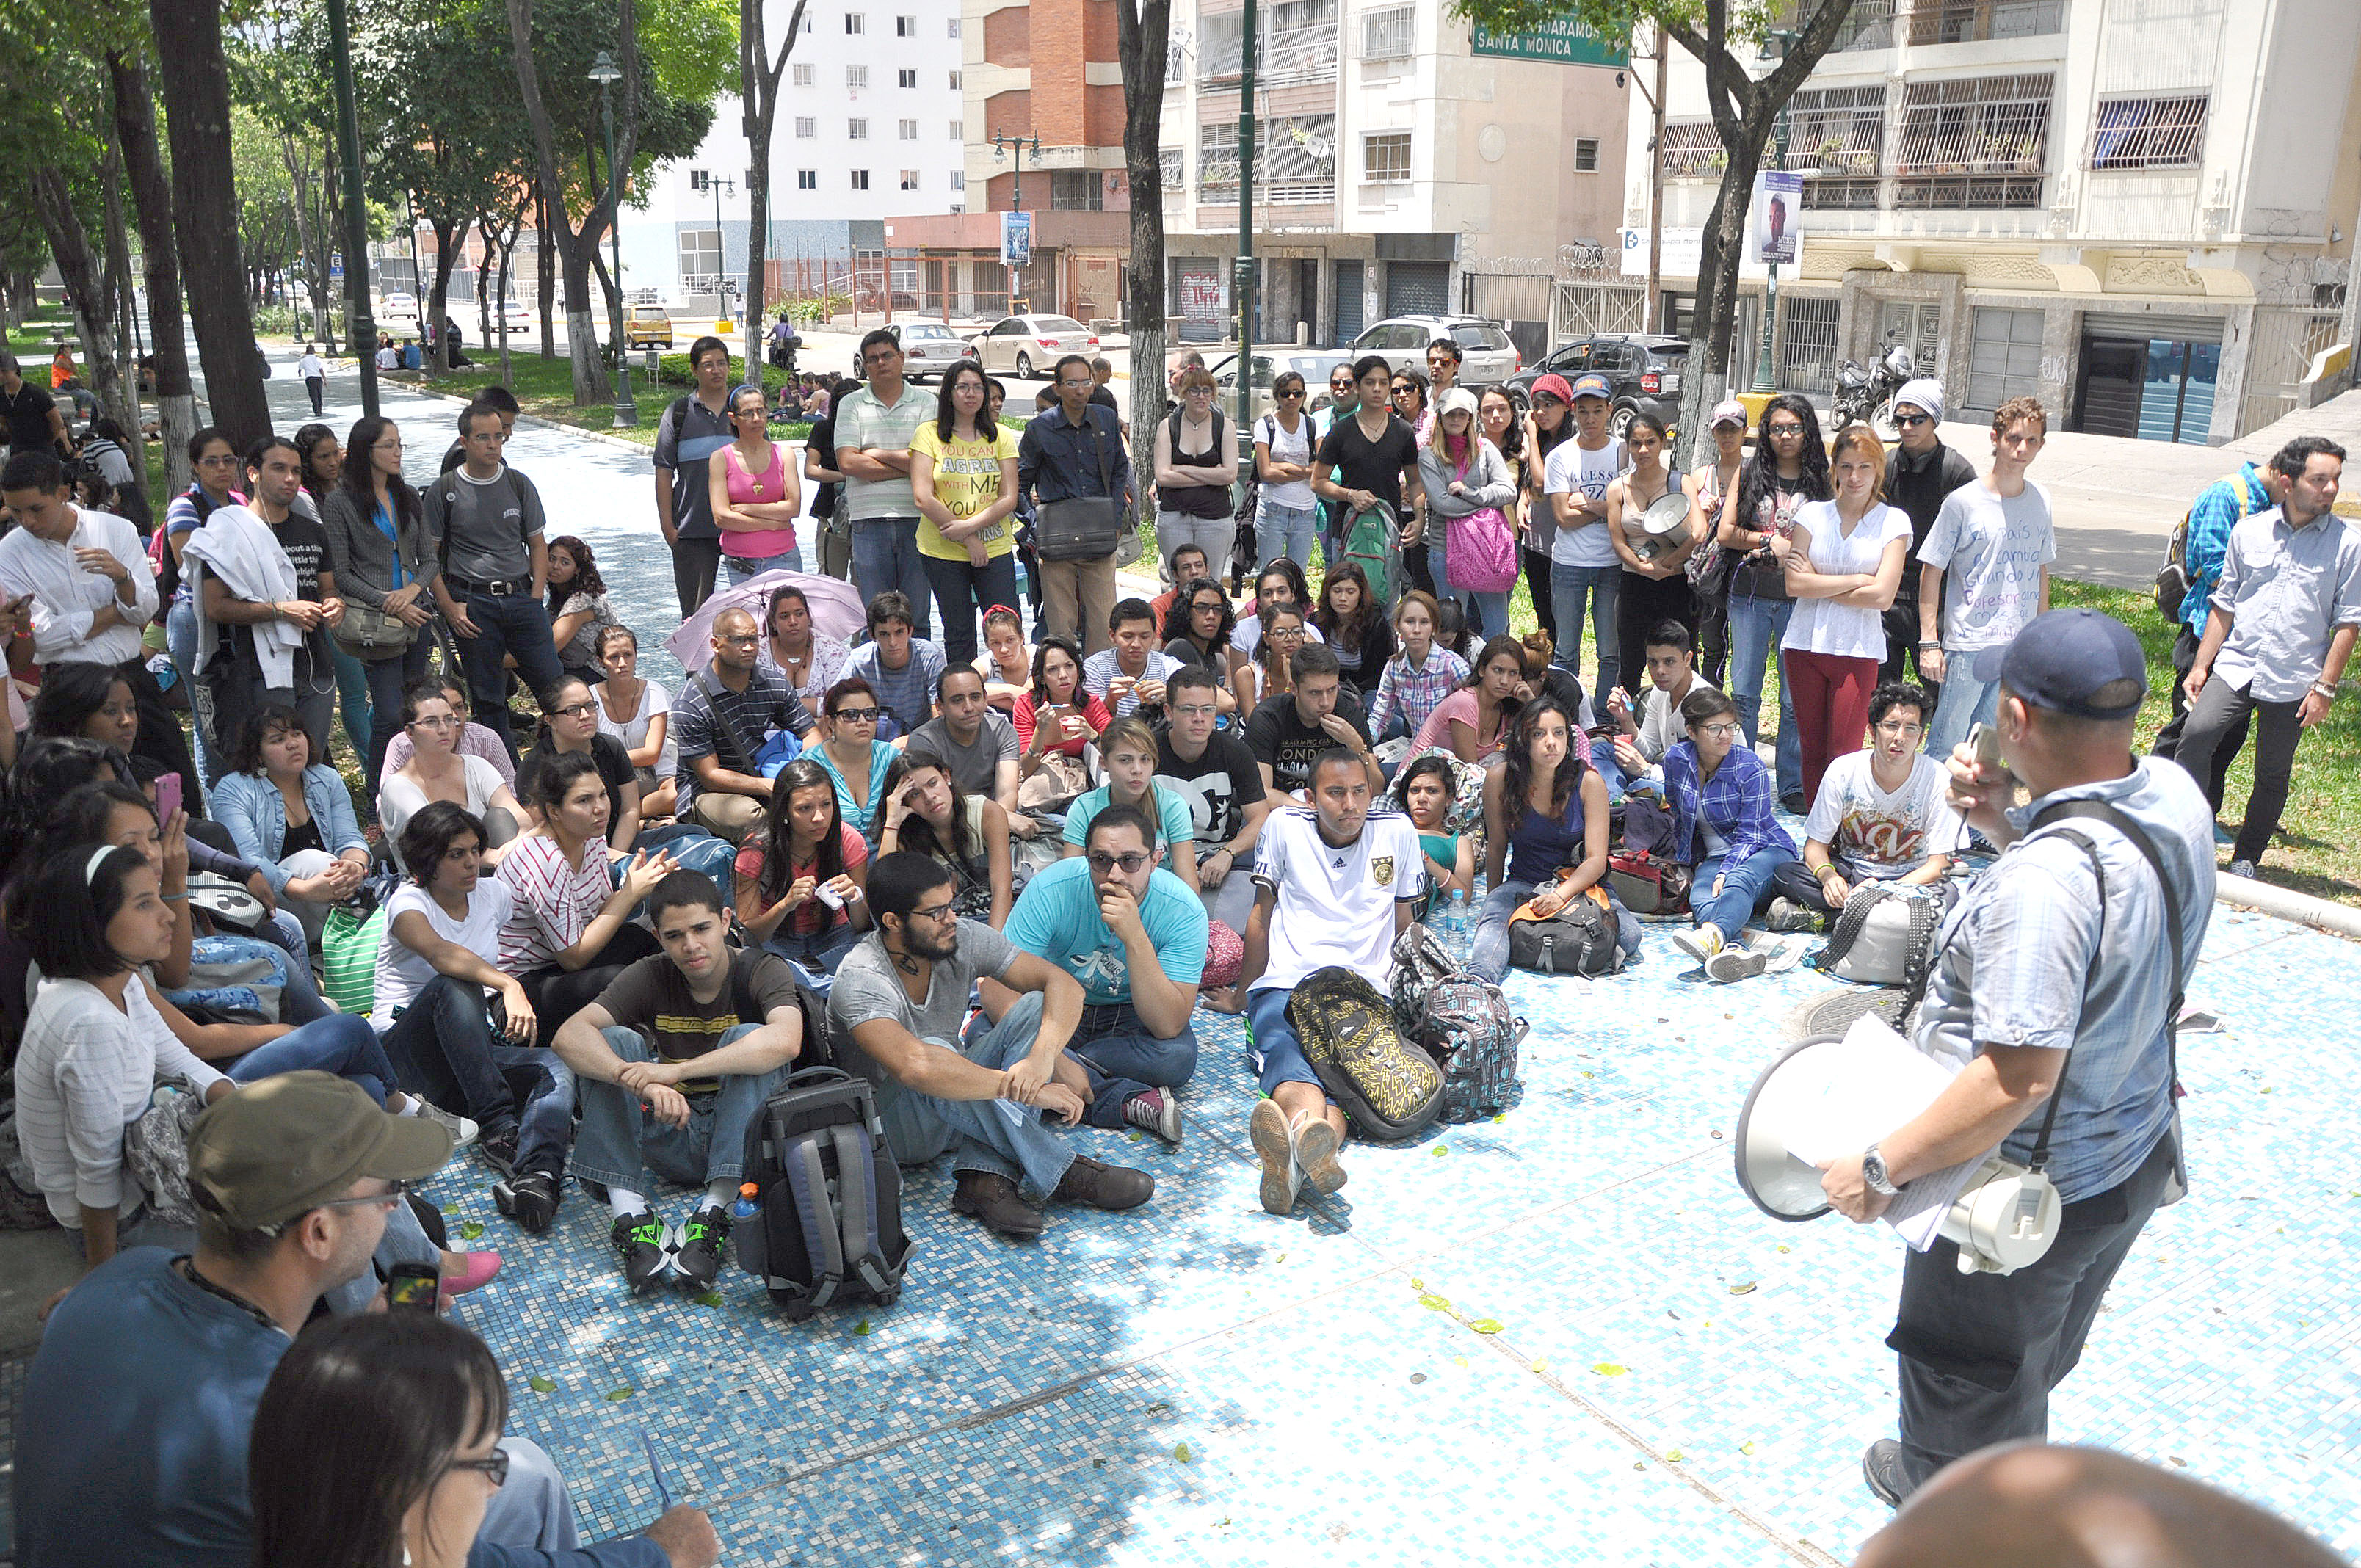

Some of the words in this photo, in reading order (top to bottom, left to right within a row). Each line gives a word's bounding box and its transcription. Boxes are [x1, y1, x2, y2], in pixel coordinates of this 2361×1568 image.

[1477, 32, 1520, 51] SANTA
[1526, 37, 1572, 57] MONICA
[333, 258, 340, 266] E
[939, 445, 965, 457] YOU
[968, 446, 994, 457] CAN
[943, 480, 968, 490] WITH
[971, 474, 1001, 495] ME
[1570, 470, 1614, 483] GUESS
[943, 498, 976, 516] YOU
[979, 494, 992, 505] OR
[1998, 520, 2031, 547] país
[1995, 545, 2039, 565] cambia
